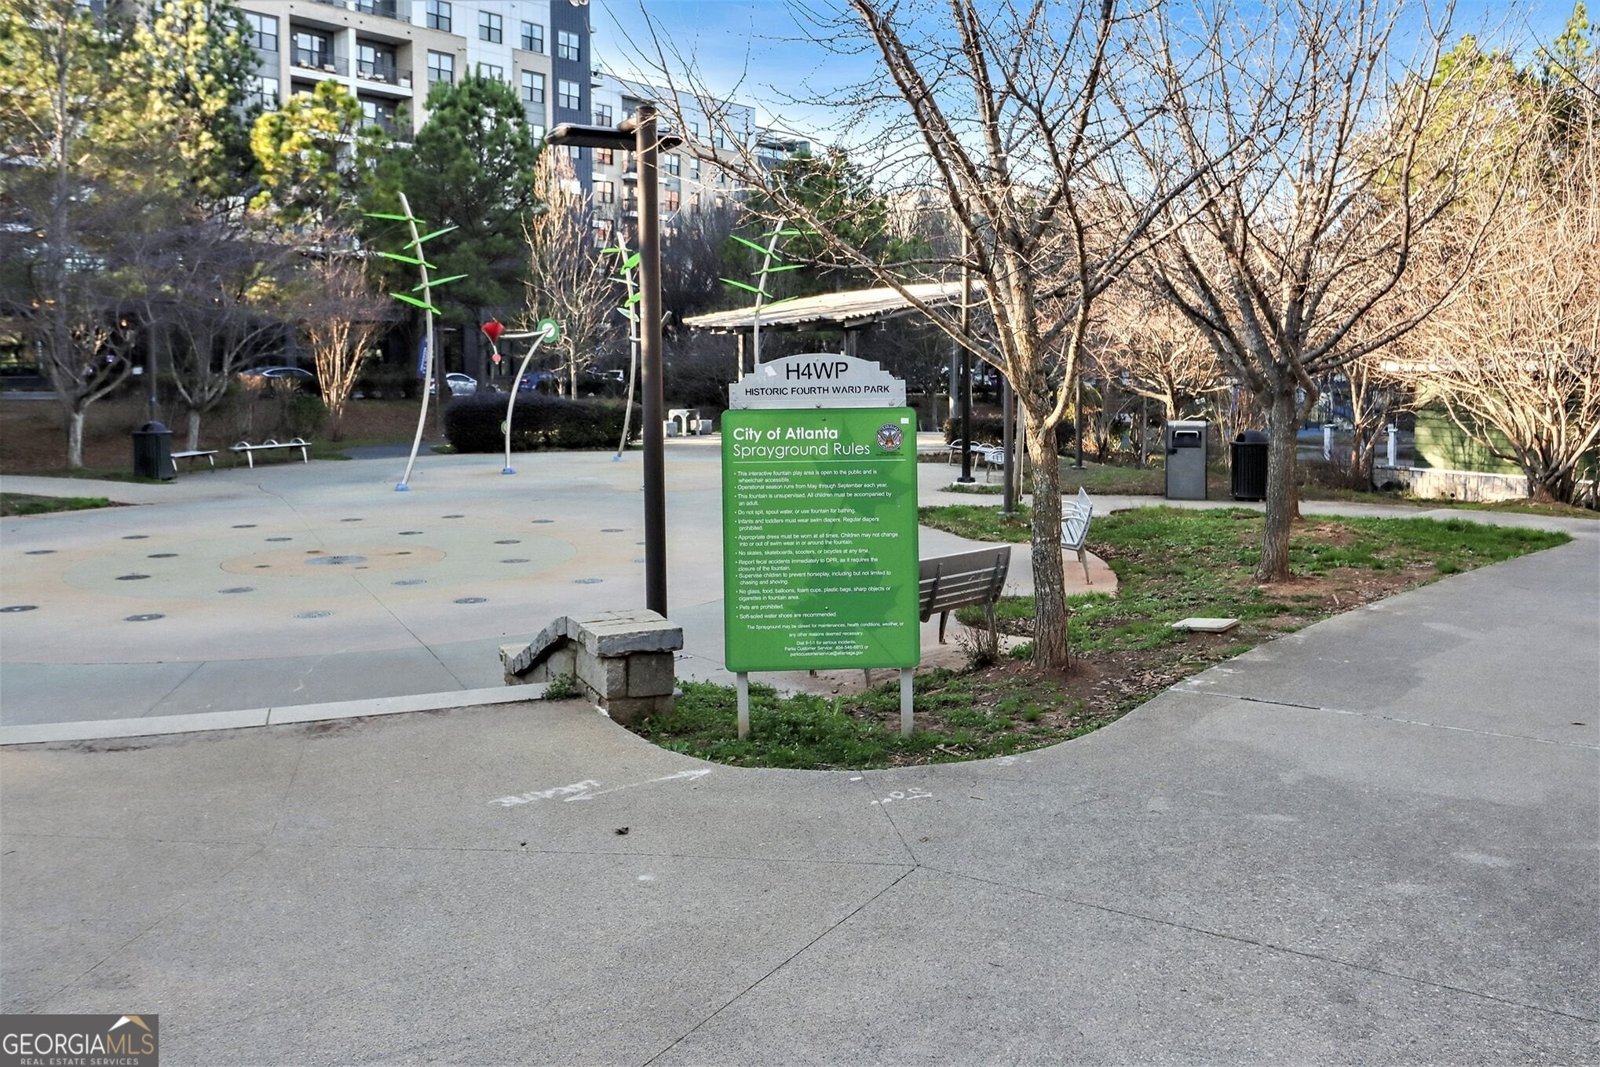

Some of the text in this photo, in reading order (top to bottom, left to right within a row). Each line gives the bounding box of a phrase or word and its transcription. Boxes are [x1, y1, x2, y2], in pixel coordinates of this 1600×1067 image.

[786, 362, 848, 380] H4WP
[745, 387, 788, 396] HISTORIC
[791, 387, 829, 395] FOURTH
[832, 386, 861, 394] WARD
[733, 427, 838, 442] City of Atlanta
[733, 443, 870, 458] Sprayground Rules
